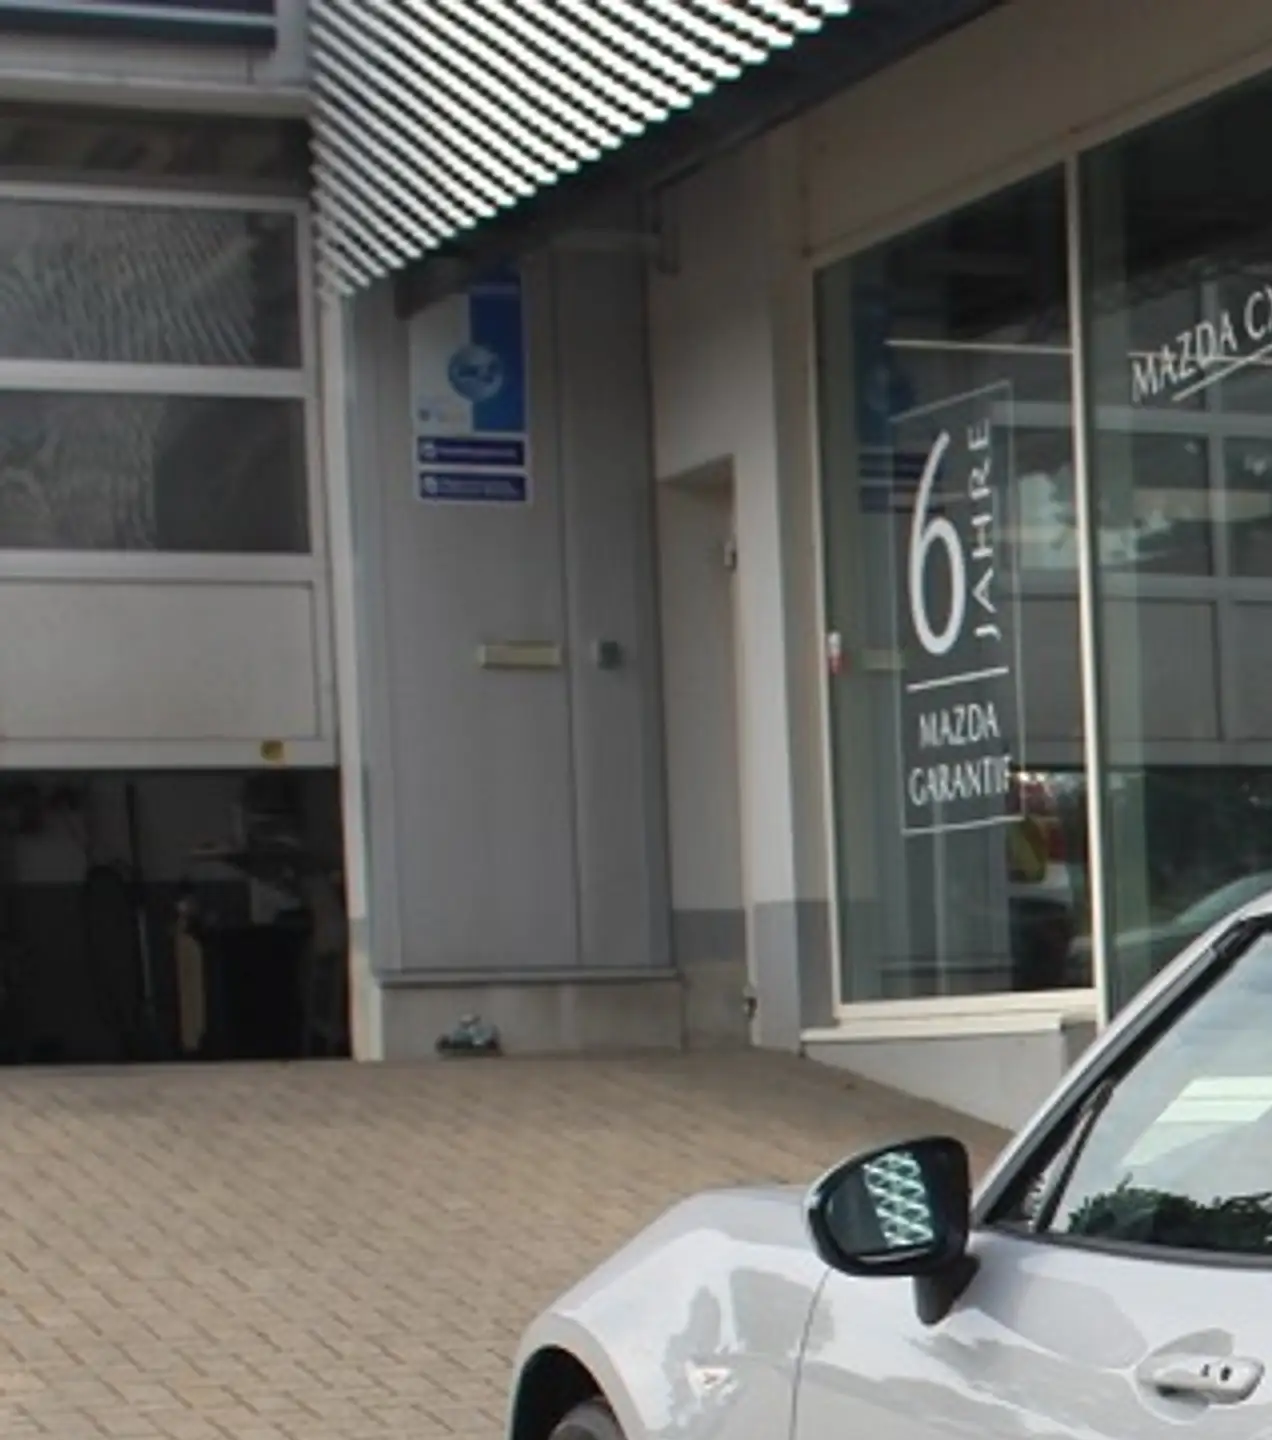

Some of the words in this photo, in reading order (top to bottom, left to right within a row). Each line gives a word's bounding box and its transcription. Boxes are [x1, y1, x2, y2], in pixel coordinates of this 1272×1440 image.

[1132, 310, 1238, 402] MAZDA
[908, 431, 966, 654] 6
[967, 418, 1002, 640] JAHRE
[919, 701, 1000, 748] MAZDA
